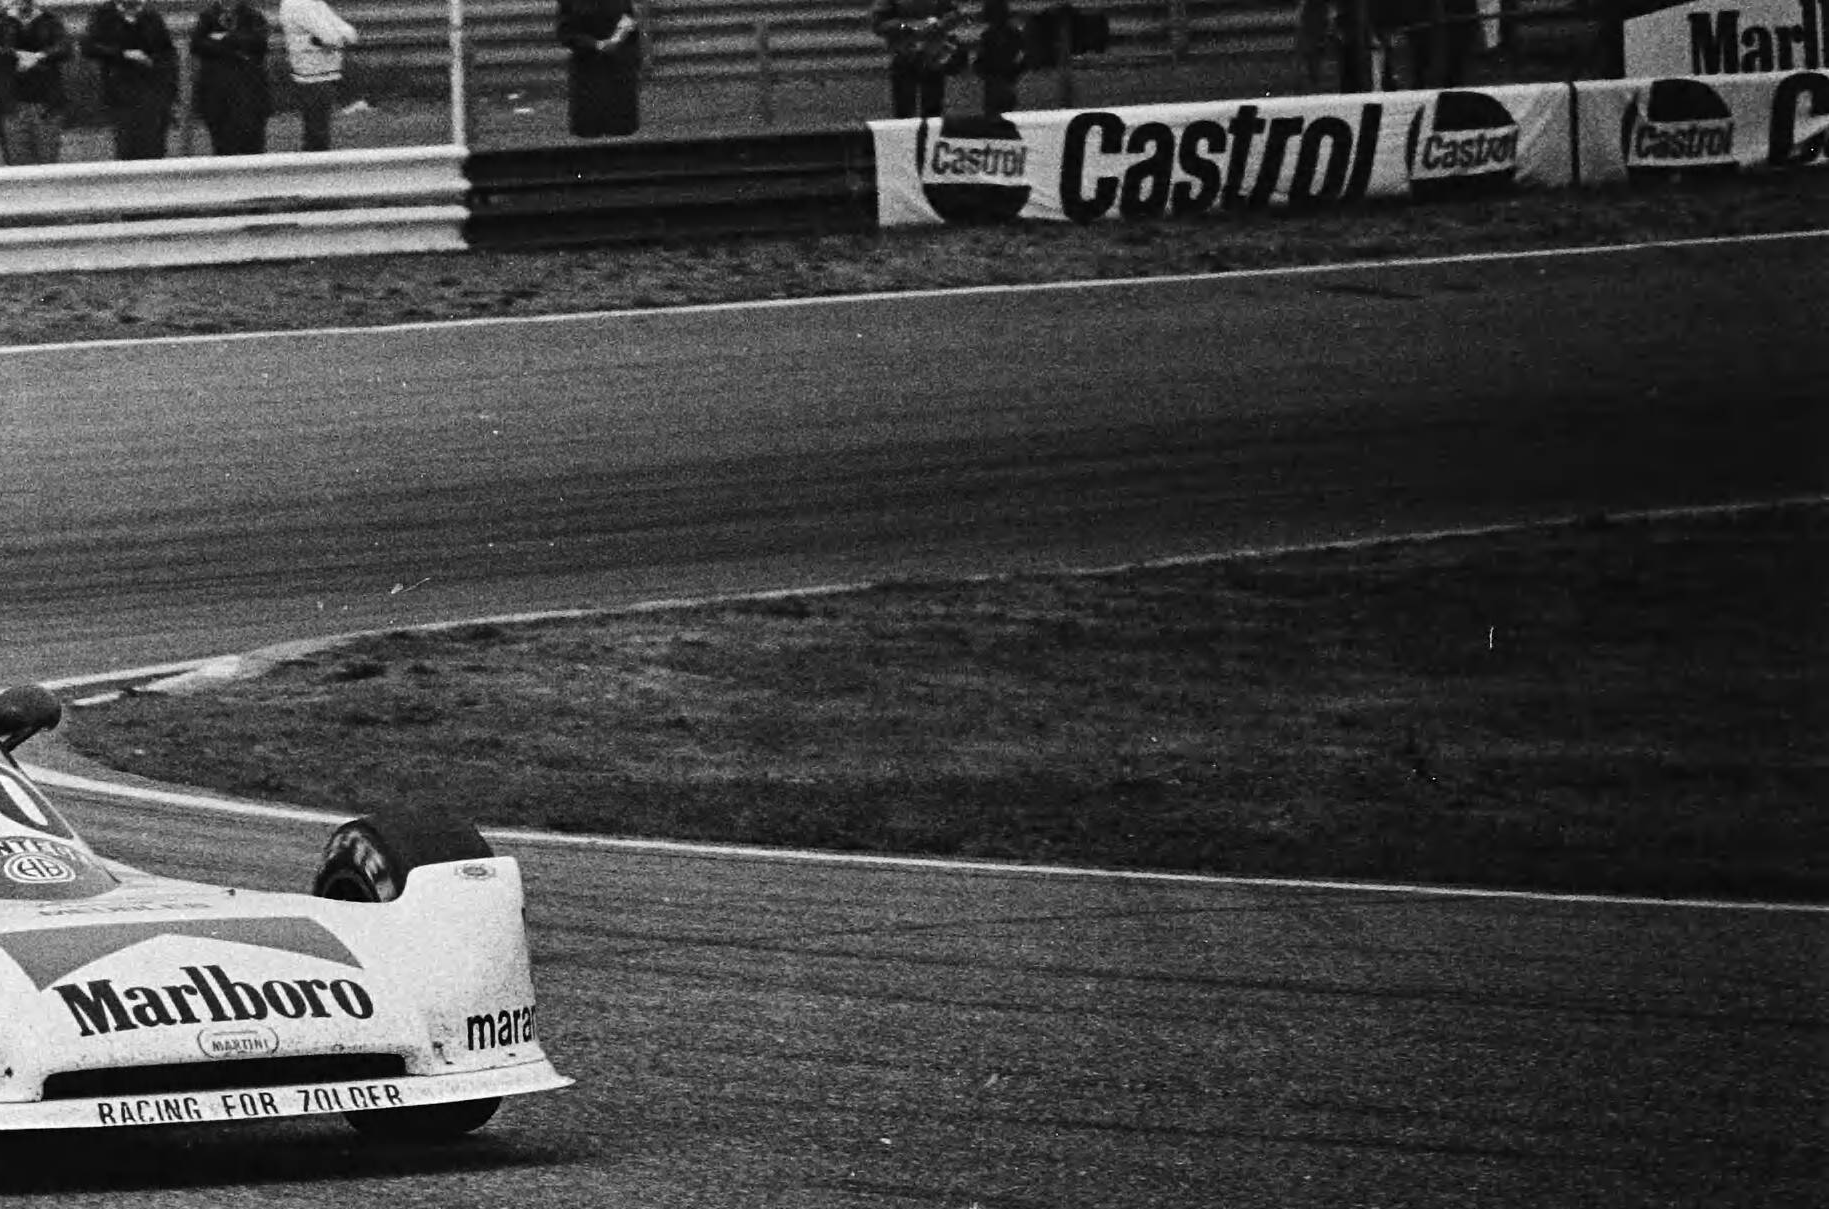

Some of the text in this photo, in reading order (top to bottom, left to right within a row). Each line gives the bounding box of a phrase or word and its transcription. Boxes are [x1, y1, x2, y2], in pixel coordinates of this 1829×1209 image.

[1687, 0, 1829, 75] Marl
[931, 140, 1028, 178] Castrol
[1059, 103, 1384, 222] Castrol
[1422, 126, 1519, 171] Castrol
[1634, 121, 1735, 159] Castrol
[51, 965, 375, 1037] Marlboro
[97, 1095, 203, 1125] RACING
[220, 1091, 280, 1118] FOR
